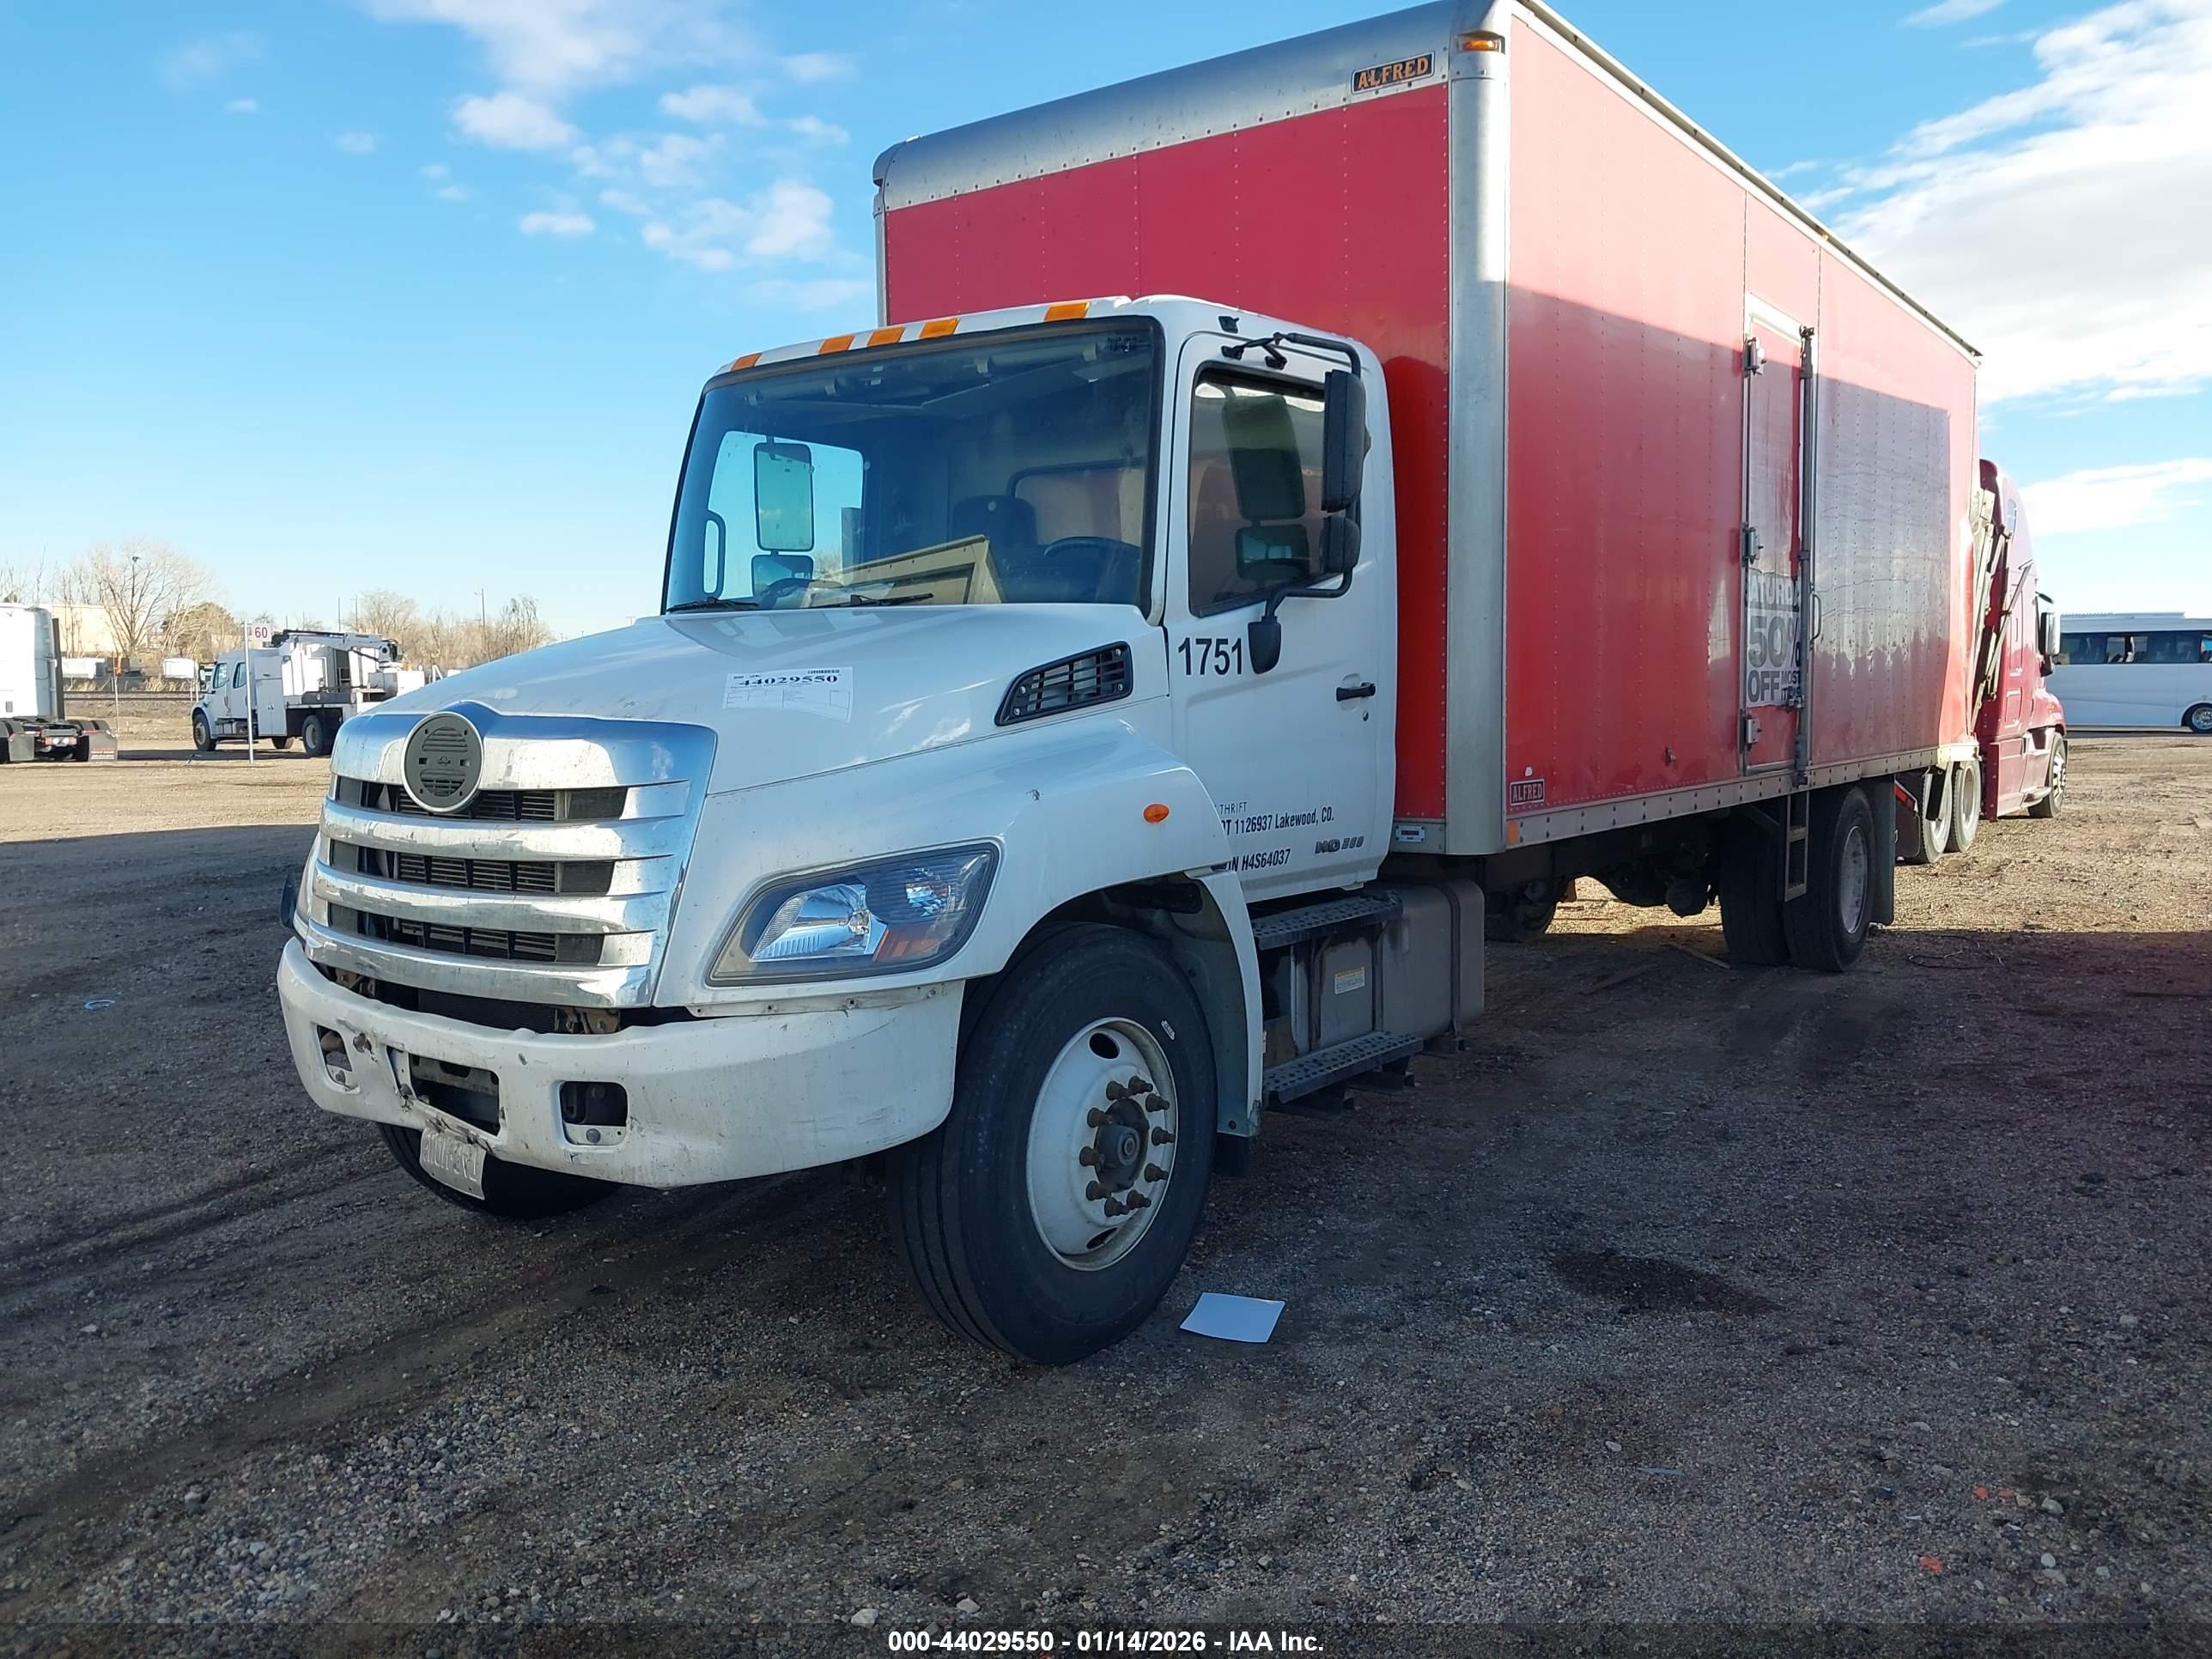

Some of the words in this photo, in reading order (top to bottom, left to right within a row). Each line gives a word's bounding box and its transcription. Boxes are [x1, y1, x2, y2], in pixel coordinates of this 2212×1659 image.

[1358, 57, 1430, 89] ALFRED
[254, 626, 268, 639] 60
[1178, 637, 1243, 676] 1751
[739, 675, 838, 686] 44029550
[1747, 670, 1780, 702] OFF
[1512, 783, 1543, 802] ALFRED
[1219, 801, 1248, 815] THRIFT
[1235, 814, 1273, 835] 1126937
[1275, 808, 1319, 830] Lakewood,
[1322, 806, 1334, 823] CO.
